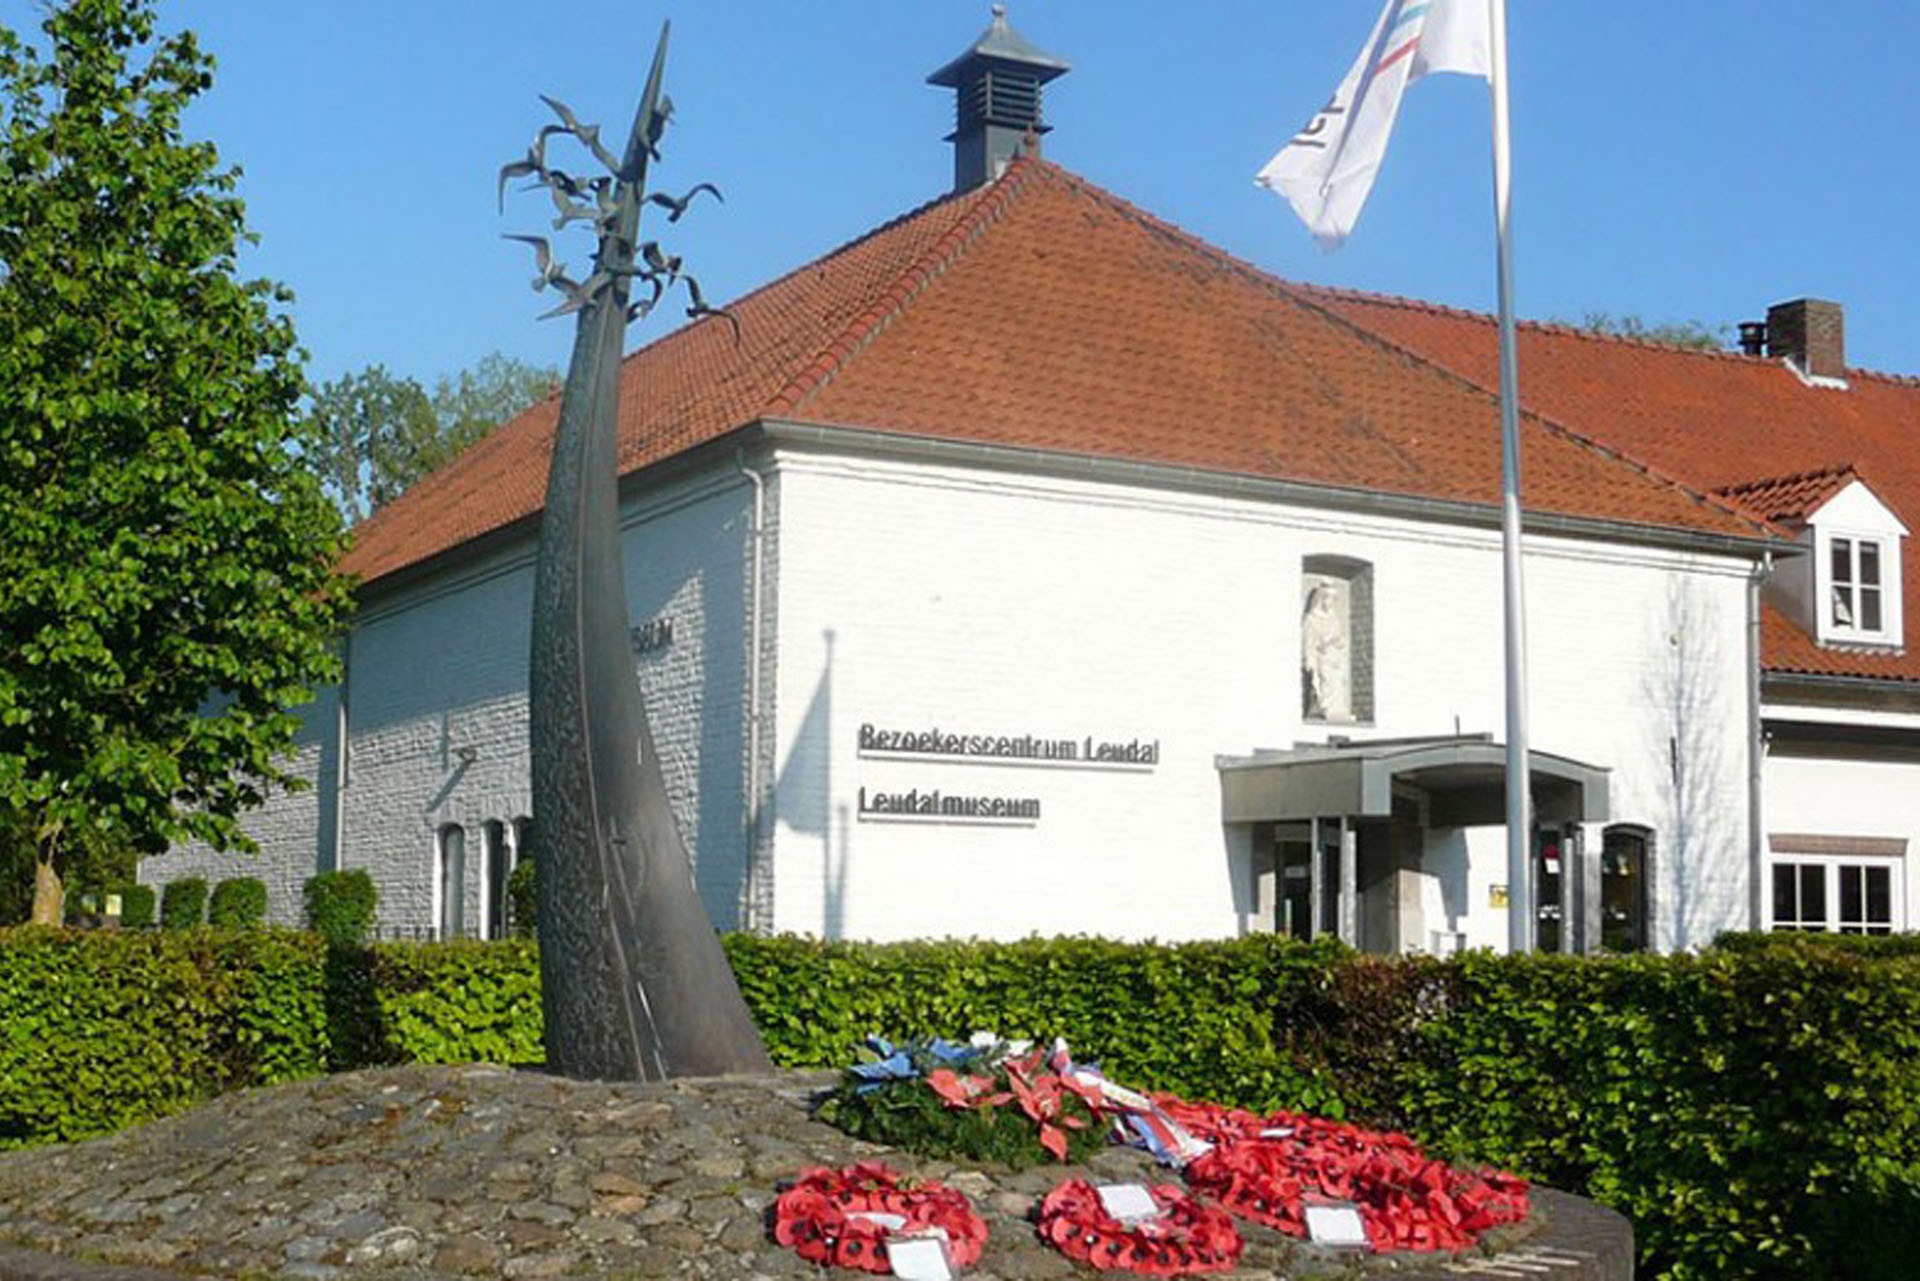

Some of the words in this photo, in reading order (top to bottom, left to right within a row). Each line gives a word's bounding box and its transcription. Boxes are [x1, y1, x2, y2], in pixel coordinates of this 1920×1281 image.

[858, 723, 1077, 760] Bezoekerscentrum
[1084, 735, 1159, 765] Leudal
[858, 786, 1040, 818] Leudalmuseum
